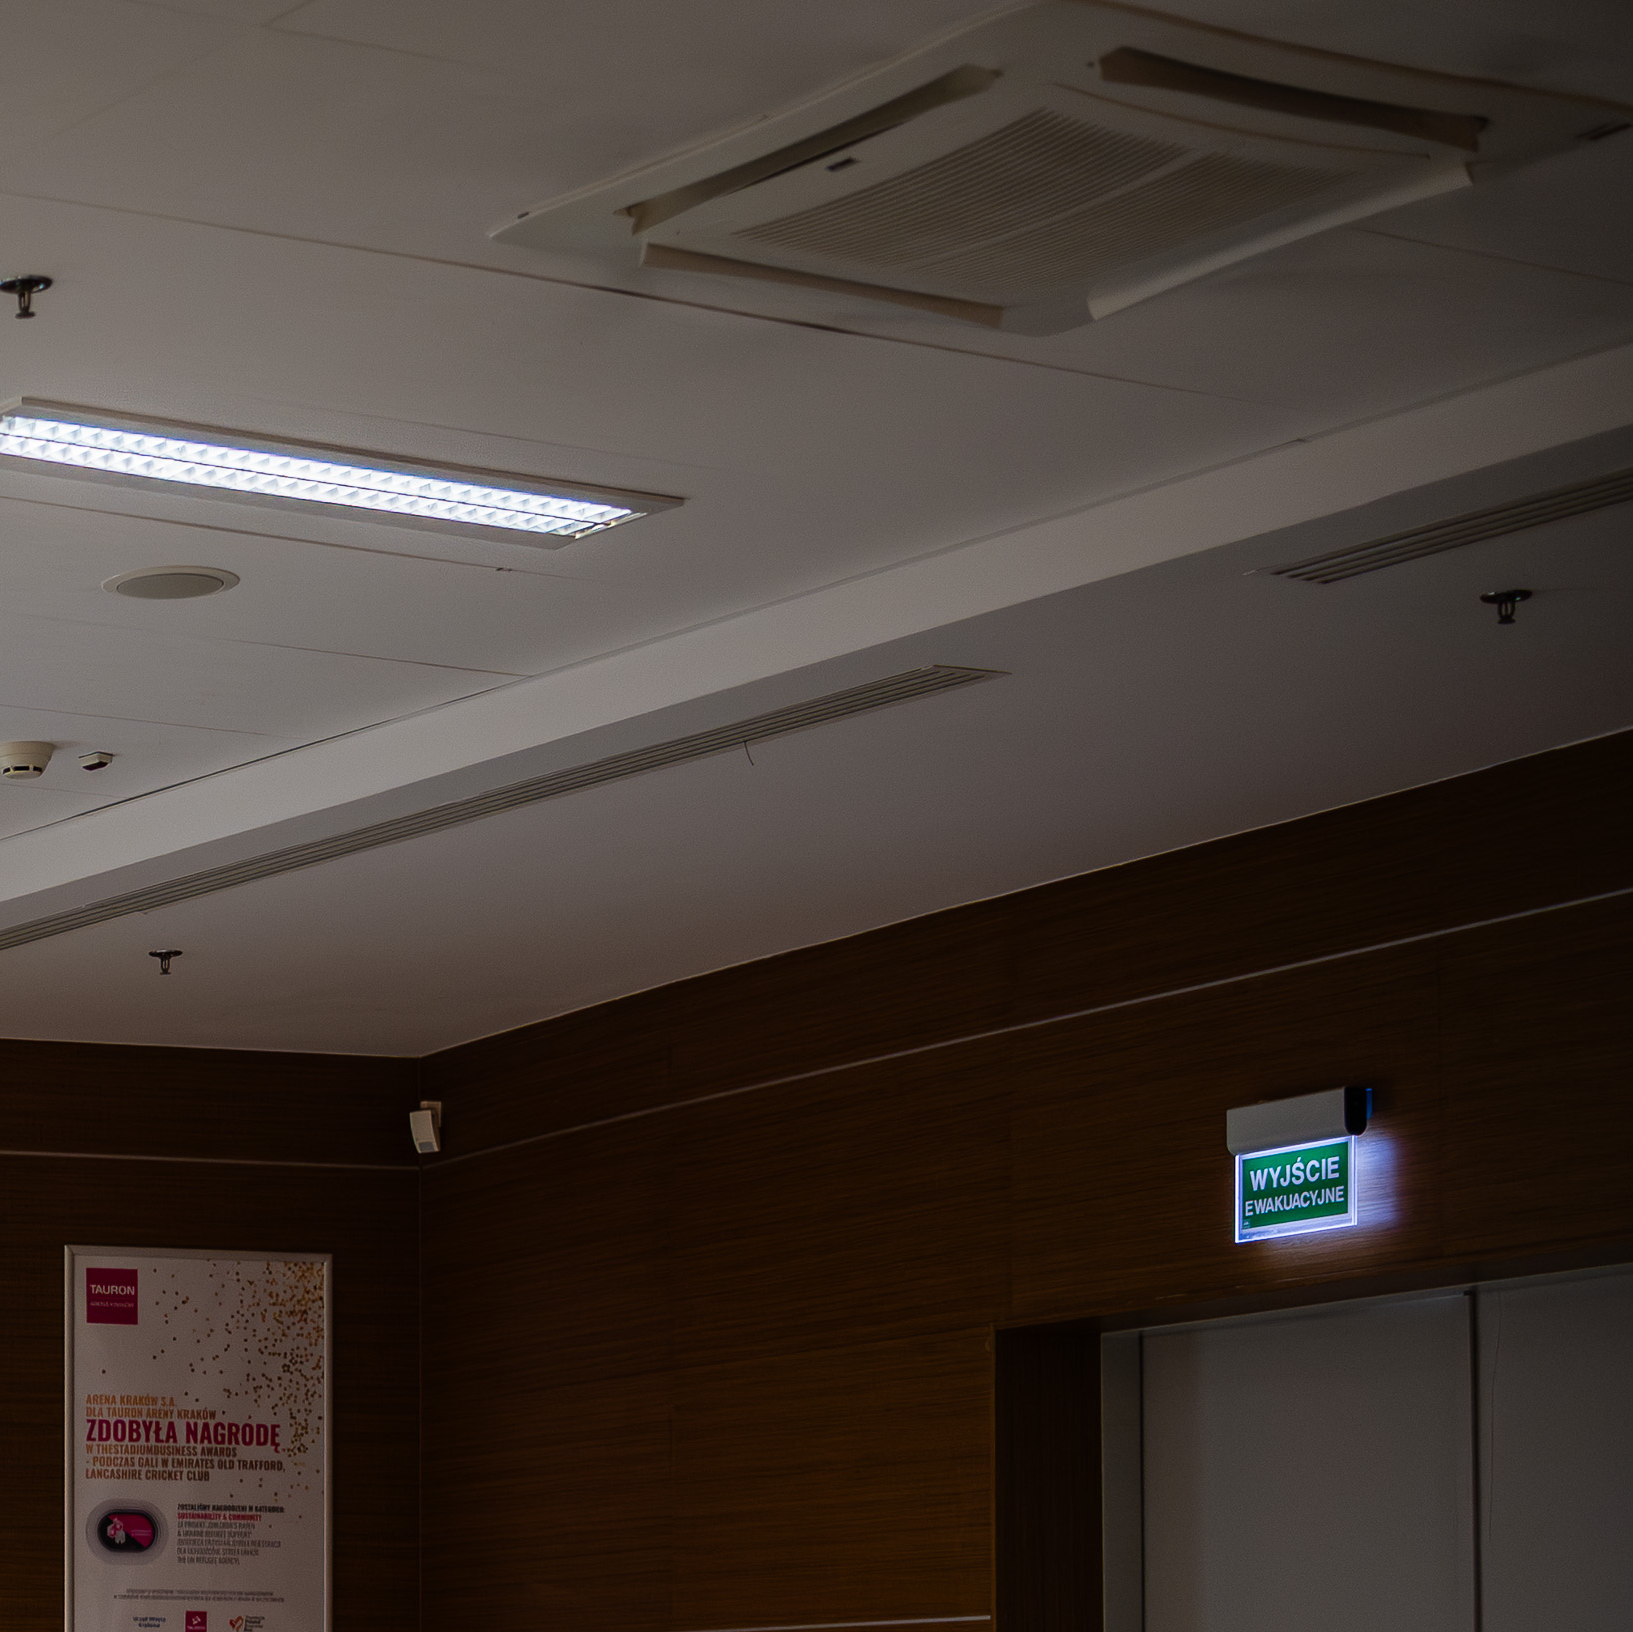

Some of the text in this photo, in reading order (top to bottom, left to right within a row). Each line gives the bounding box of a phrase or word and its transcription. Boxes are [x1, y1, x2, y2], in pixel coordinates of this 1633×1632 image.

[1249, 1156, 1340, 1192] WYJŚCIE
[1245, 1185, 1345, 1217] EWAKUACYJNE
[89, 1284, 135, 1296] TAURON
[86, 1394, 117, 1405] ARENA
[86, 1407, 217, 1420] DLA TAURON ARENY KRAKÓW
[86, 1419, 281, 1453] ZDOBYŁA NAGRODĘ
[86, 1444, 93, 1454] W
[200, 1446, 237, 1458] AWARDS
[92, 1456, 135, 1467] PODCZAS
[137, 1457, 159, 1468] GALI
[161, 1457, 169, 1468] W
[171, 1458, 215, 1470] EMIRATES
[217, 1459, 235, 1470] OLD
[145, 1469, 184, 1481] CRICKET
[186, 1471, 210, 1482] CLUB
